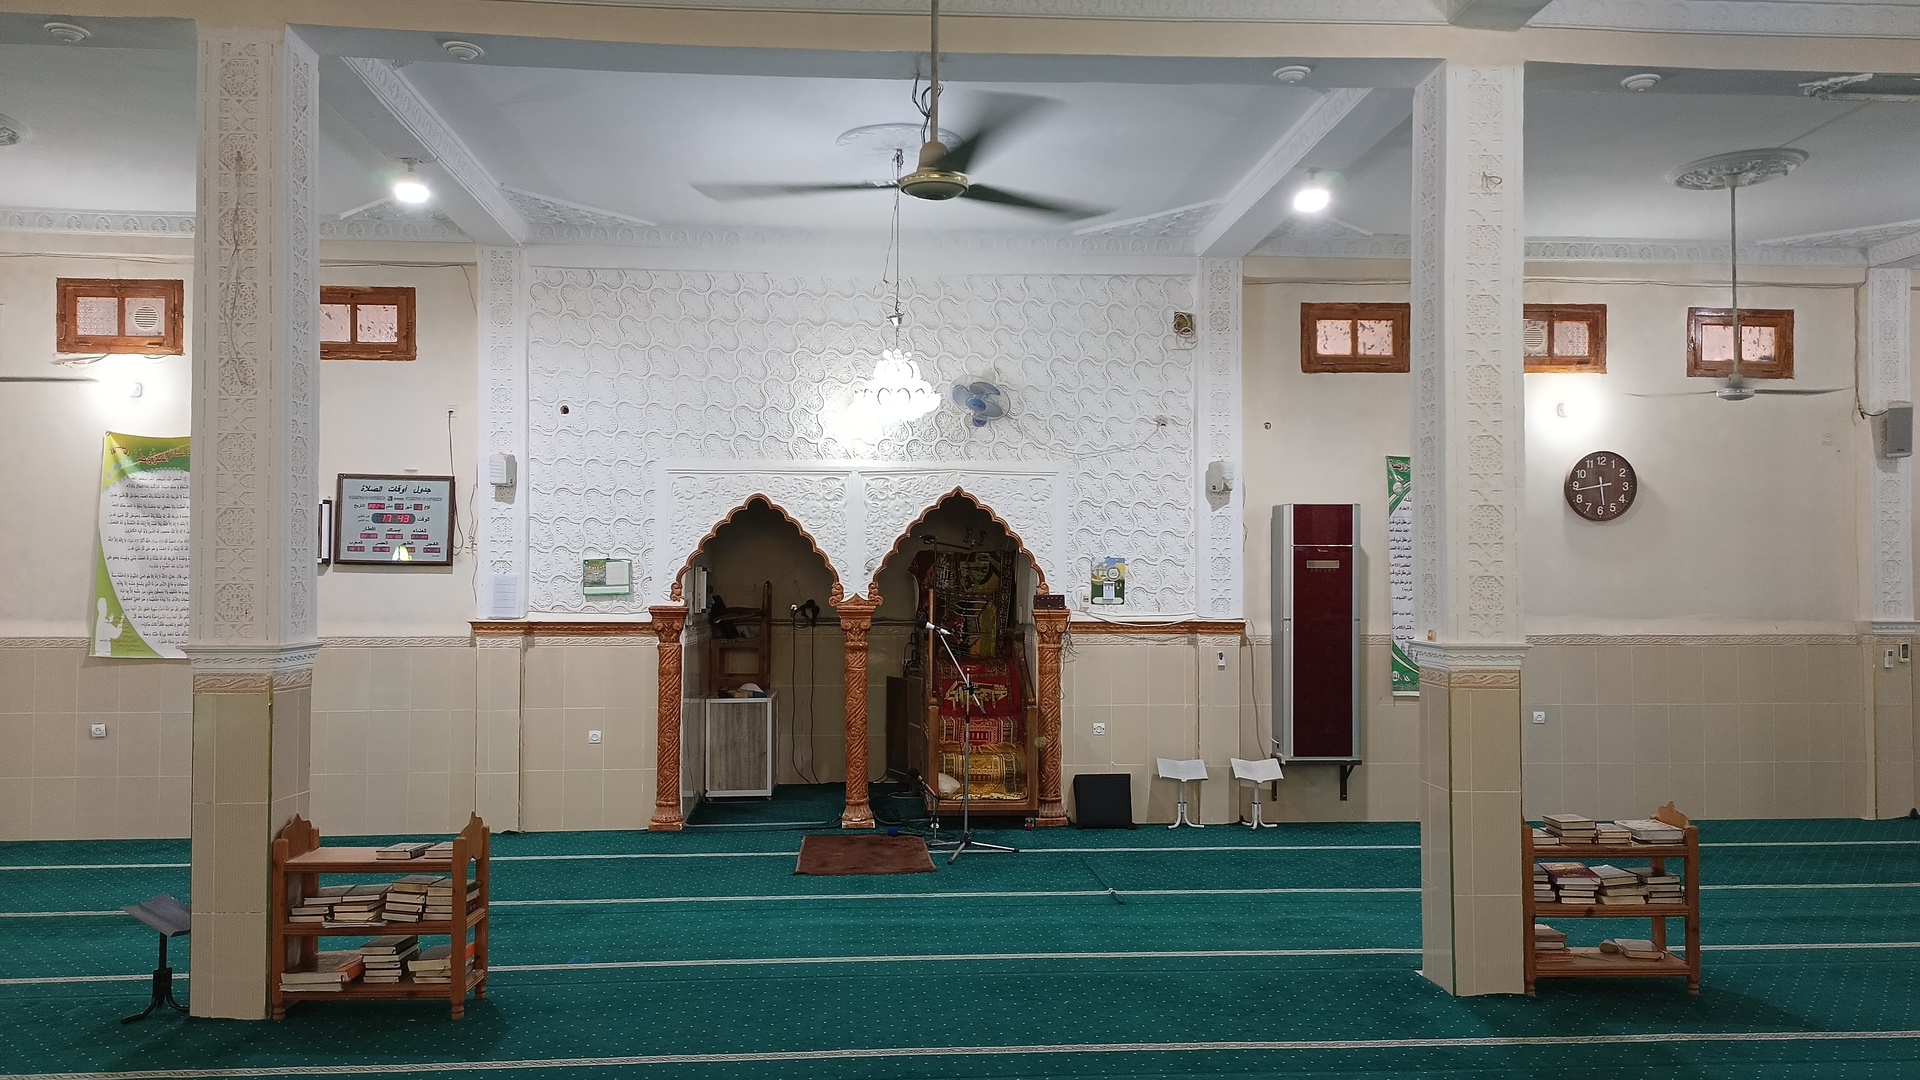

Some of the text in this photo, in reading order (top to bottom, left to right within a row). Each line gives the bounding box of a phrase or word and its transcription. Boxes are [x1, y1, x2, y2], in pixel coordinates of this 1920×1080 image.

[1586, 460, 1594, 468] 11
[1597, 457, 1606, 466] 12
[1576, 470, 1586, 478] 10
[1620, 468, 1626, 477] 2
[388, 485, 407, 494] أوقات
[413, 486, 431, 494] جدول
[1573, 481, 1579, 490] 9
[1622, 482, 1629, 491] 3
[1576, 494, 1582, 503] 8
[1618, 494, 1626, 503] 4
[1586, 503, 1592, 511] 7
[1597, 506, 1604, 515] 6
[1610, 503, 1616, 512] 5
